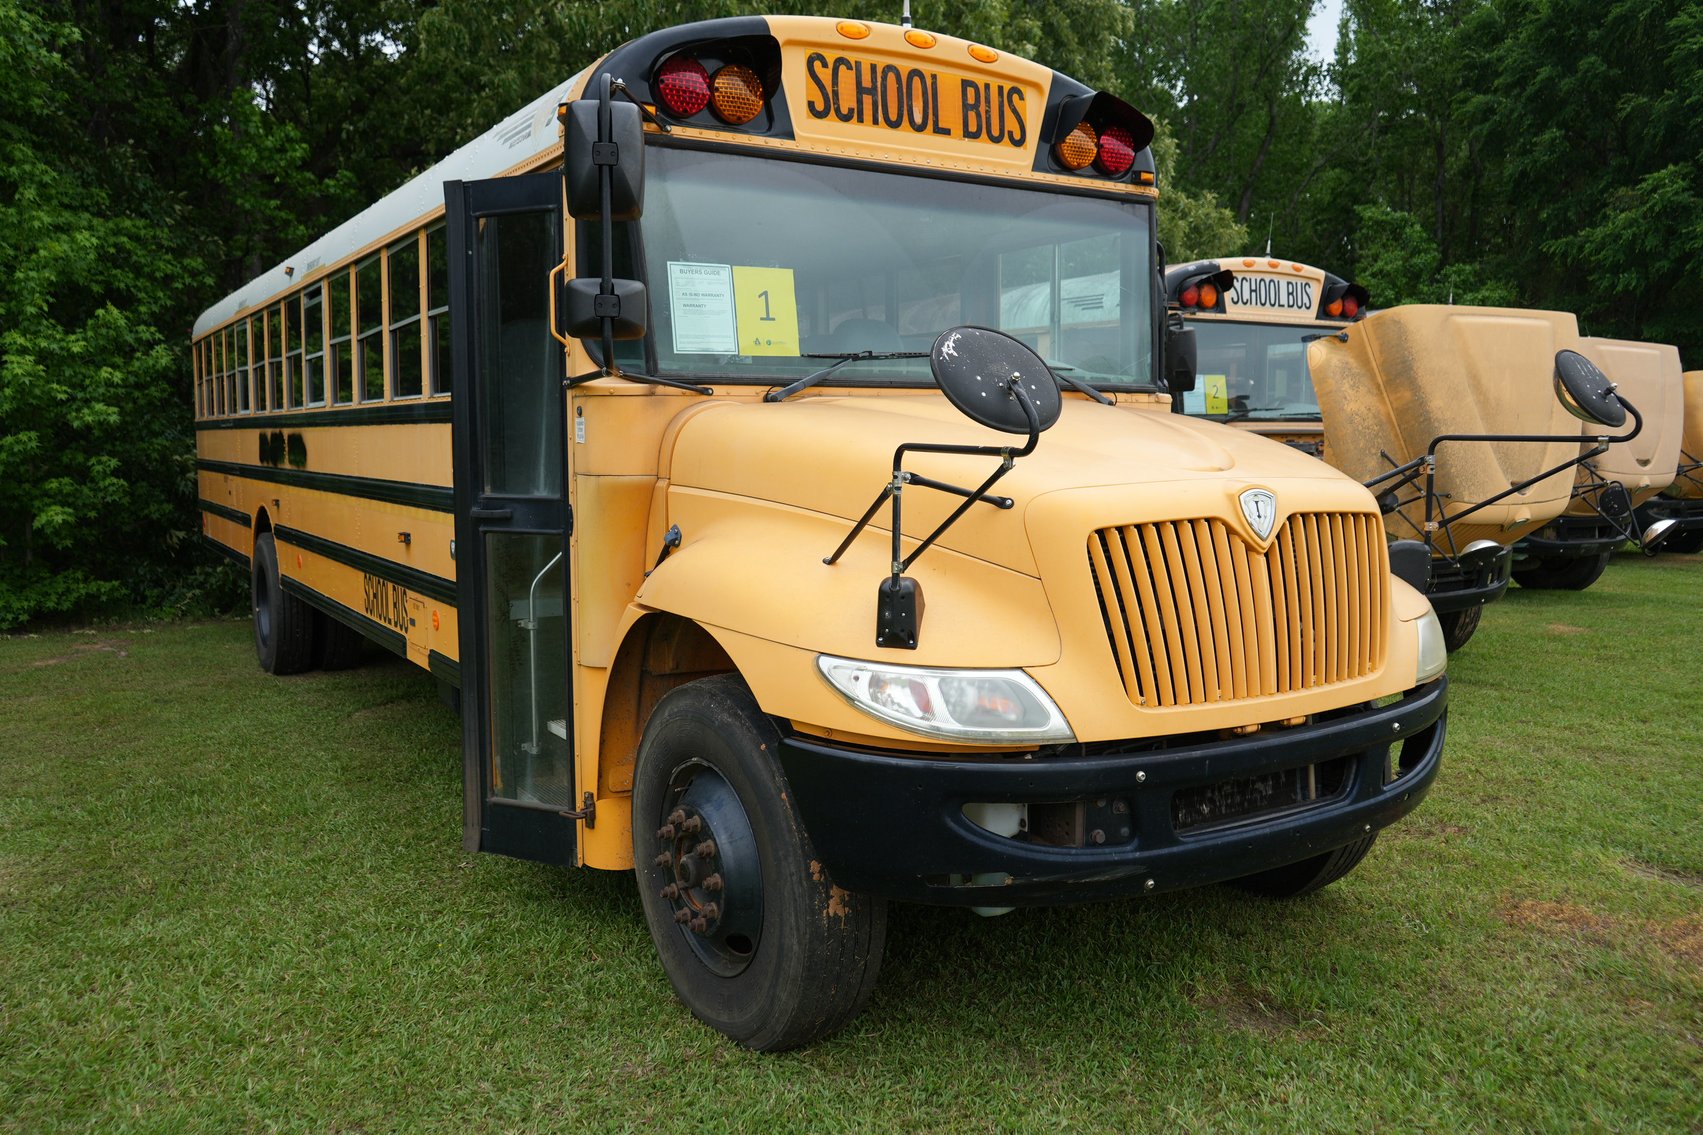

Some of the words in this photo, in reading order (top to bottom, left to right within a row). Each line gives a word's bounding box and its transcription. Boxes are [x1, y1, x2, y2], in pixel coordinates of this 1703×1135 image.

[806, 52, 951, 136] SCHOOL
[961, 78, 1027, 147] BUS
[758, 290, 776, 321] 1
[1231, 276, 1285, 308] SCHOOL
[1287, 281, 1312, 310] BUS
[1212, 384, 1220, 399] 2
[364, 573, 392, 626] SCHOOL
[392, 584, 409, 635] BUS
